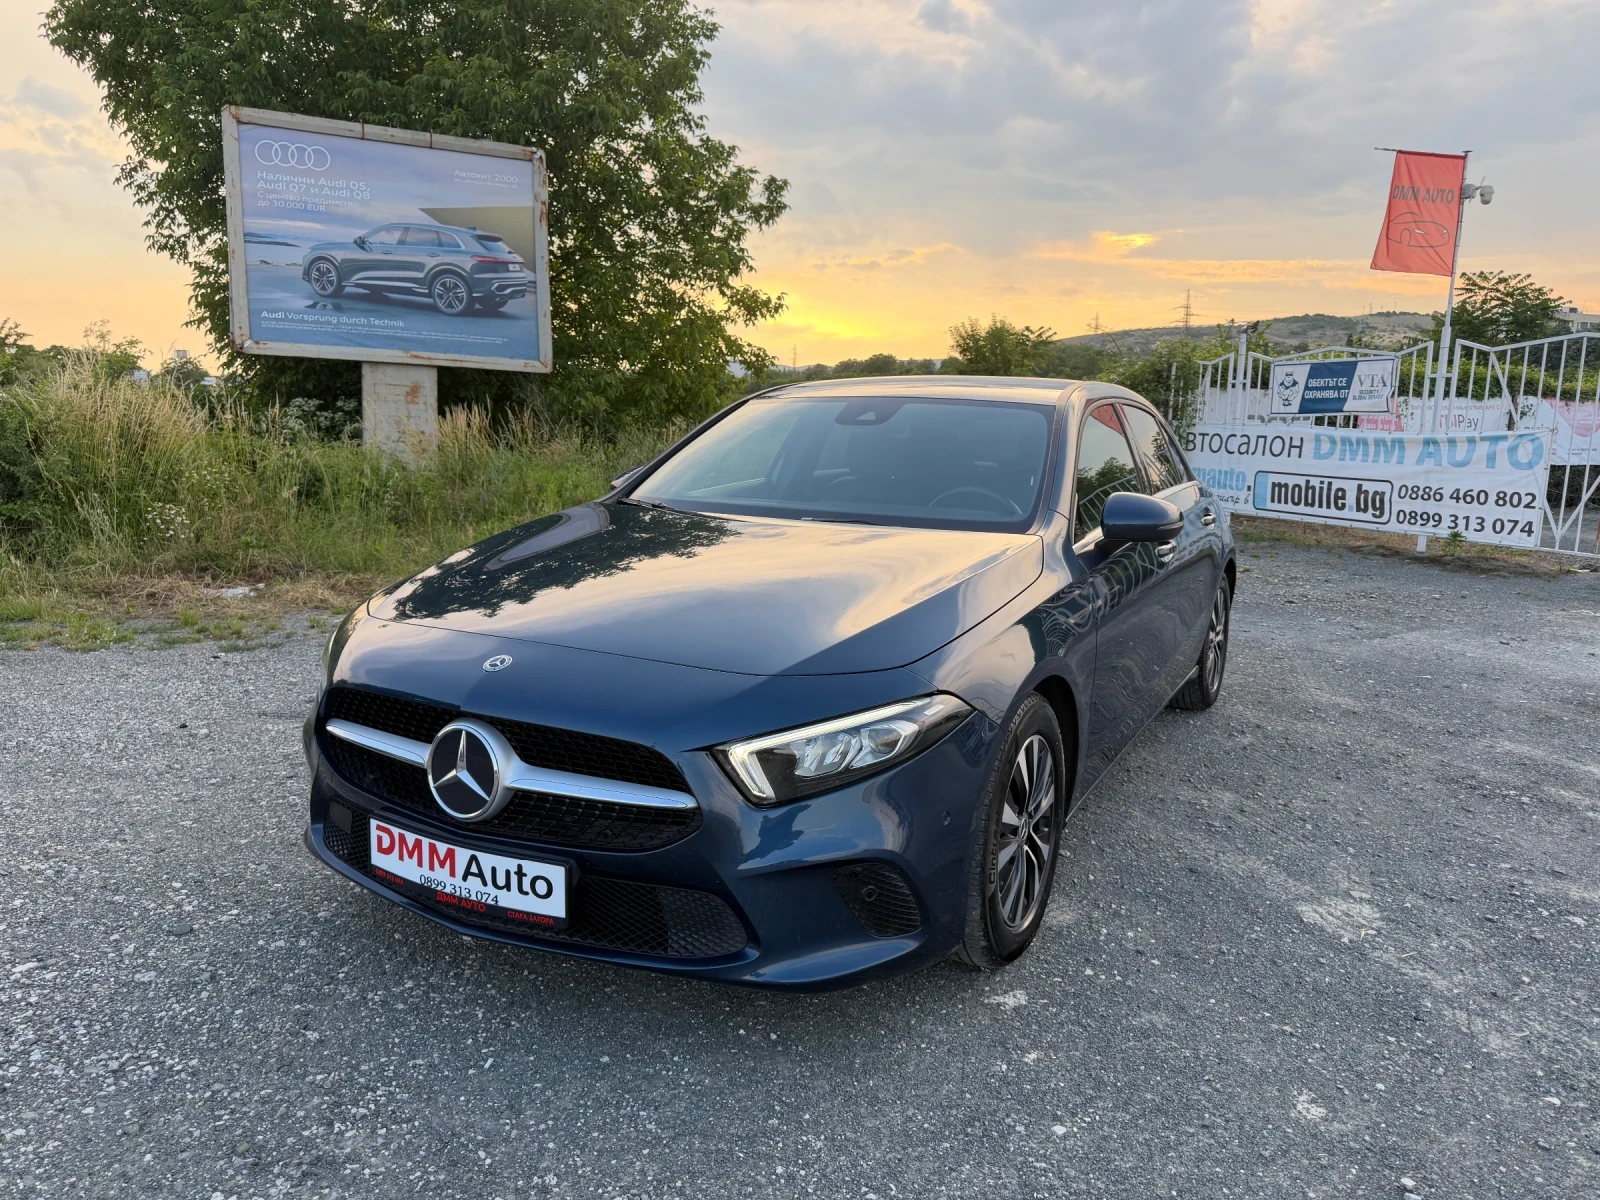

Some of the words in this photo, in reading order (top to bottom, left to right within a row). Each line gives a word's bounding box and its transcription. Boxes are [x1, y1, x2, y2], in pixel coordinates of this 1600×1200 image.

[257, 170, 315, 184] Налични
[318, 177, 346, 188] Audi
[349, 181, 371, 191] Q5,
[454, 169, 492, 180] Автохит
[494, 173, 518, 183] 2000
[257, 180, 286, 190] Audi
[289, 183, 306, 192] Q7
[321, 187, 350, 197] Audi
[353, 190, 371, 200] Q8
[266, 192, 300, 201] ценово
[302, 196, 359, 208] предимство
[1392, 184, 1421, 201] DMM
[1422, 187, 1455, 205] AUTO
[272, 199, 284, 208] 30
[286, 201, 305, 210] 000
[307, 203, 326, 212] EUR
[260, 310, 285, 319] Audi
[286, 311, 337, 324] Vorsprung
[339, 315, 367, 325] durch
[368, 317, 405, 327] Technik
[1308, 378, 1337, 387] ОБЕКТЪТ
[1338, 377, 1347, 387] СЕ
[1357, 374, 1388, 388] VTA
[1304, 389, 1338, 399] ОХРАНЯВА
[1339, 389, 1349, 399] ОТ
[1185, 432, 1304, 459] втосалон
[1312, 432, 1406, 465] DMM
[1415, 433, 1544, 471] AUTO
[1192, 466, 1252, 492] mauto.
[1270, 479, 1387, 519] mobile.bg
[1397, 484, 1444, 502] 0886
[1449, 487, 1489, 505] 460
[1494, 490, 1537, 509] 802
[1396, 509, 1443, 528] 0899
[1447, 513, 1486, 532] 313
[1492, 518, 1535, 537] 074
[375, 823, 456, 879] DMM
[461, 853, 554, 900] Auto
[419, 874, 447, 891] 0899
[449, 883, 472, 899] 313
[475, 890, 500, 906] 074
[436, 891, 459, 905] ДММ
[460, 898, 487, 913] АУТО
[507, 910, 528, 920] СТАРА
[529, 914, 555, 925] ЗАГОРА
